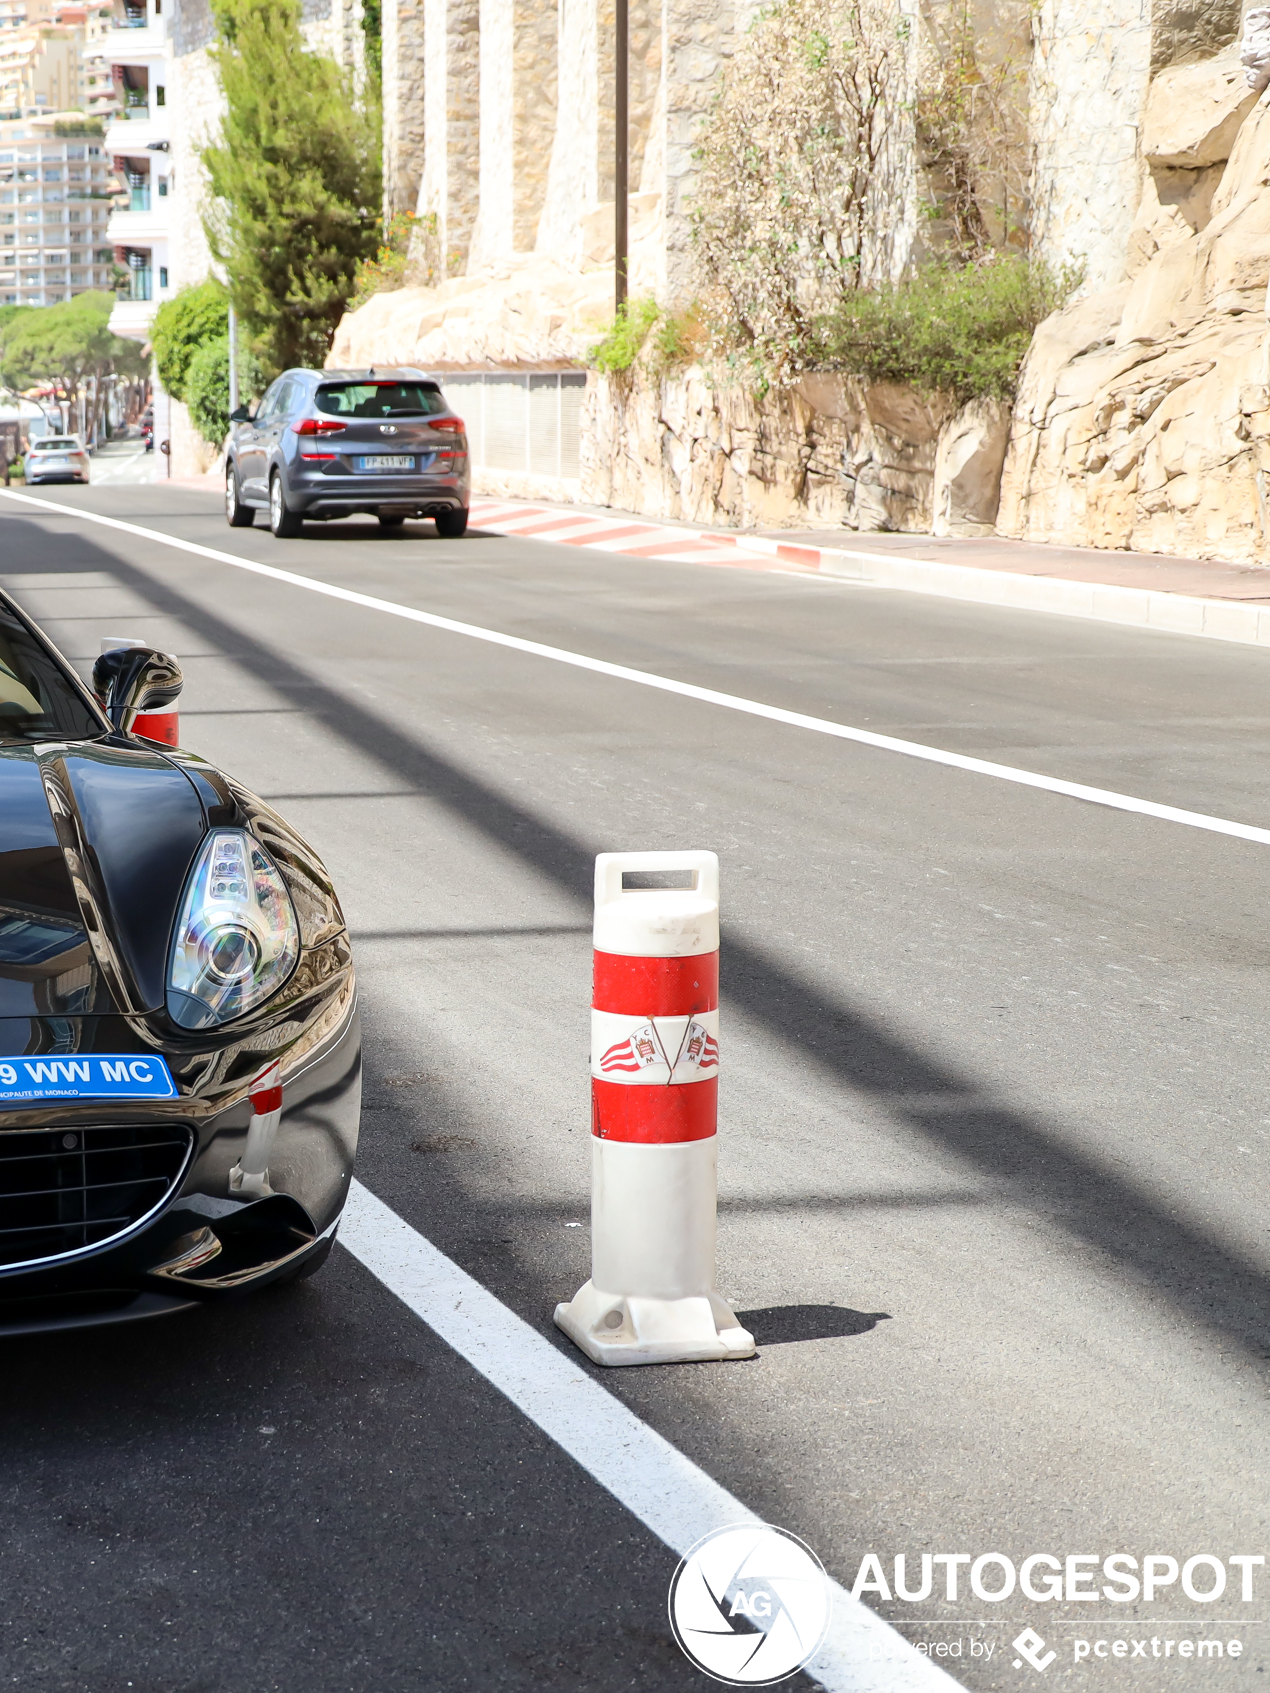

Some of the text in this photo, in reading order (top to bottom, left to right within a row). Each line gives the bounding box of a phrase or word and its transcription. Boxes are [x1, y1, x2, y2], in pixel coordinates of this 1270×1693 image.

[23, 1060, 90, 1083] WW
[99, 1060, 154, 1083] MC
[34, 1089, 45, 1097] DE
[45, 1088, 79, 1096] MONACO
